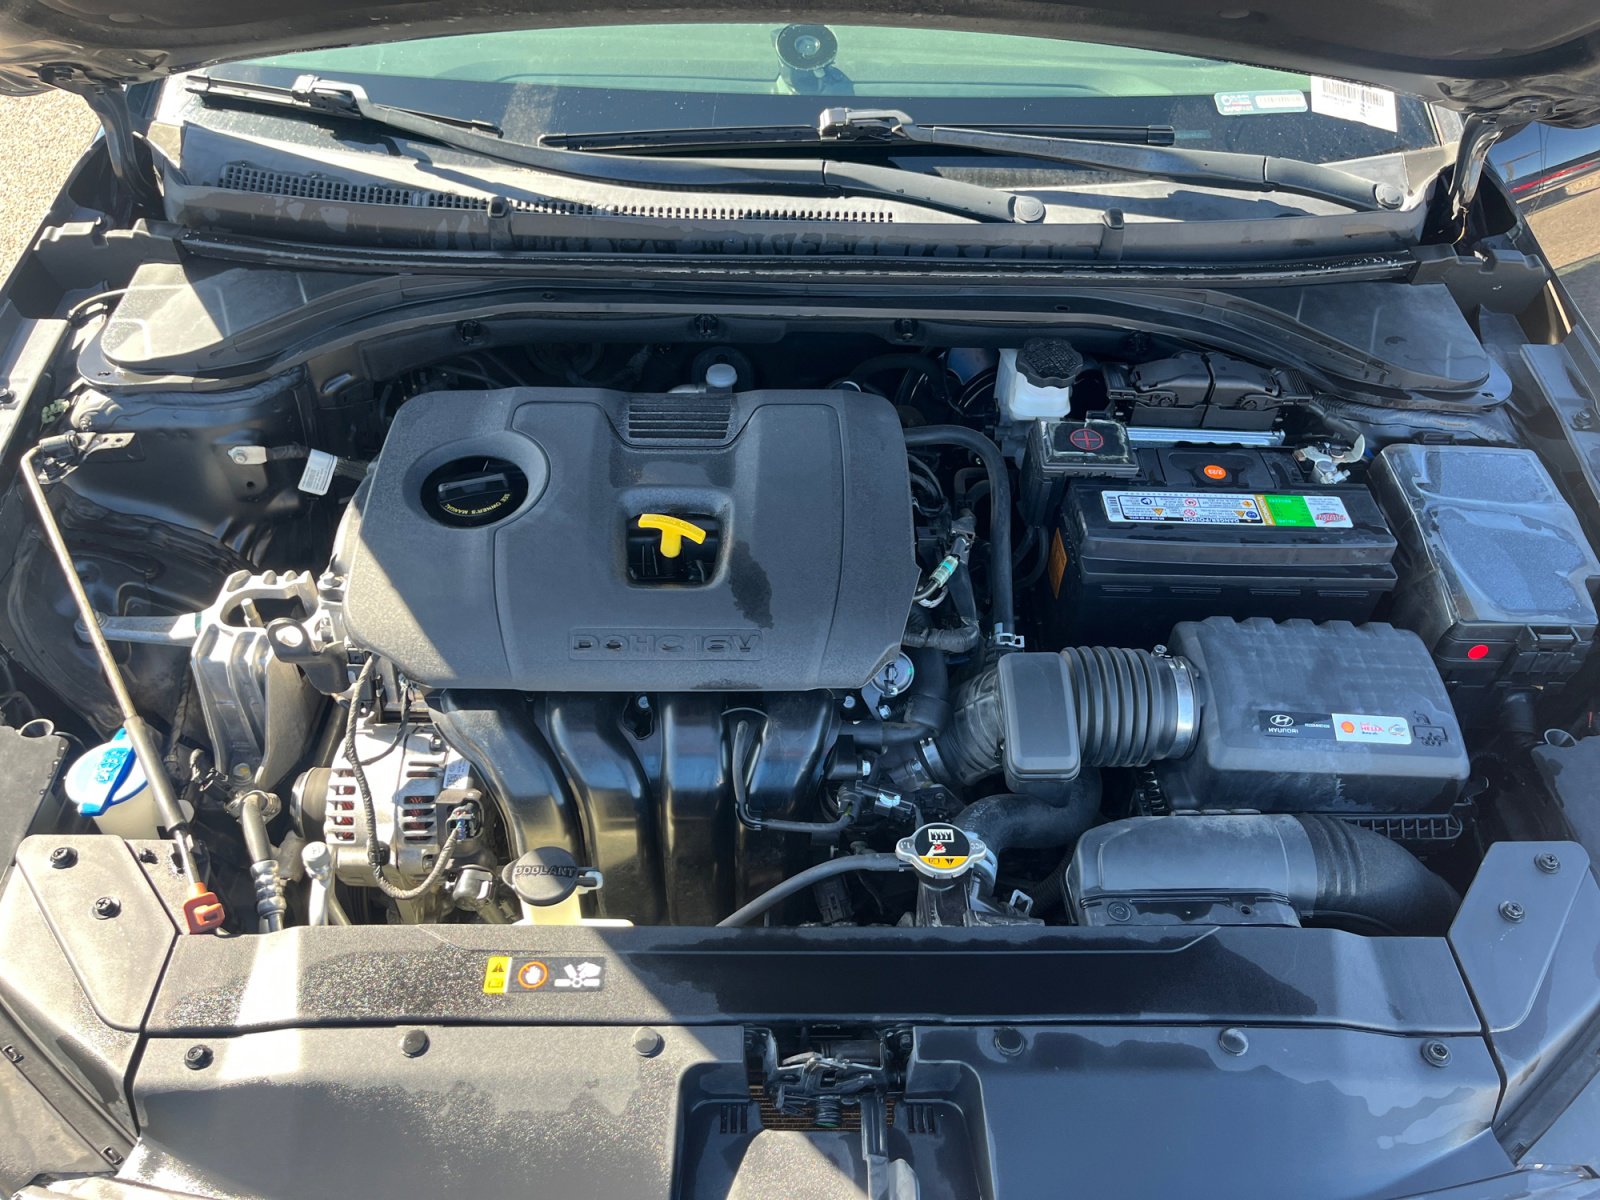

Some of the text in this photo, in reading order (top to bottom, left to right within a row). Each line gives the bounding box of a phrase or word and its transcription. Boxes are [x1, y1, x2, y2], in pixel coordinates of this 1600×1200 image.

[445, 503, 469, 515] MANUAL
[573, 634, 759, 653] DOHC 16V
[515, 864, 577, 878] COOLANT
